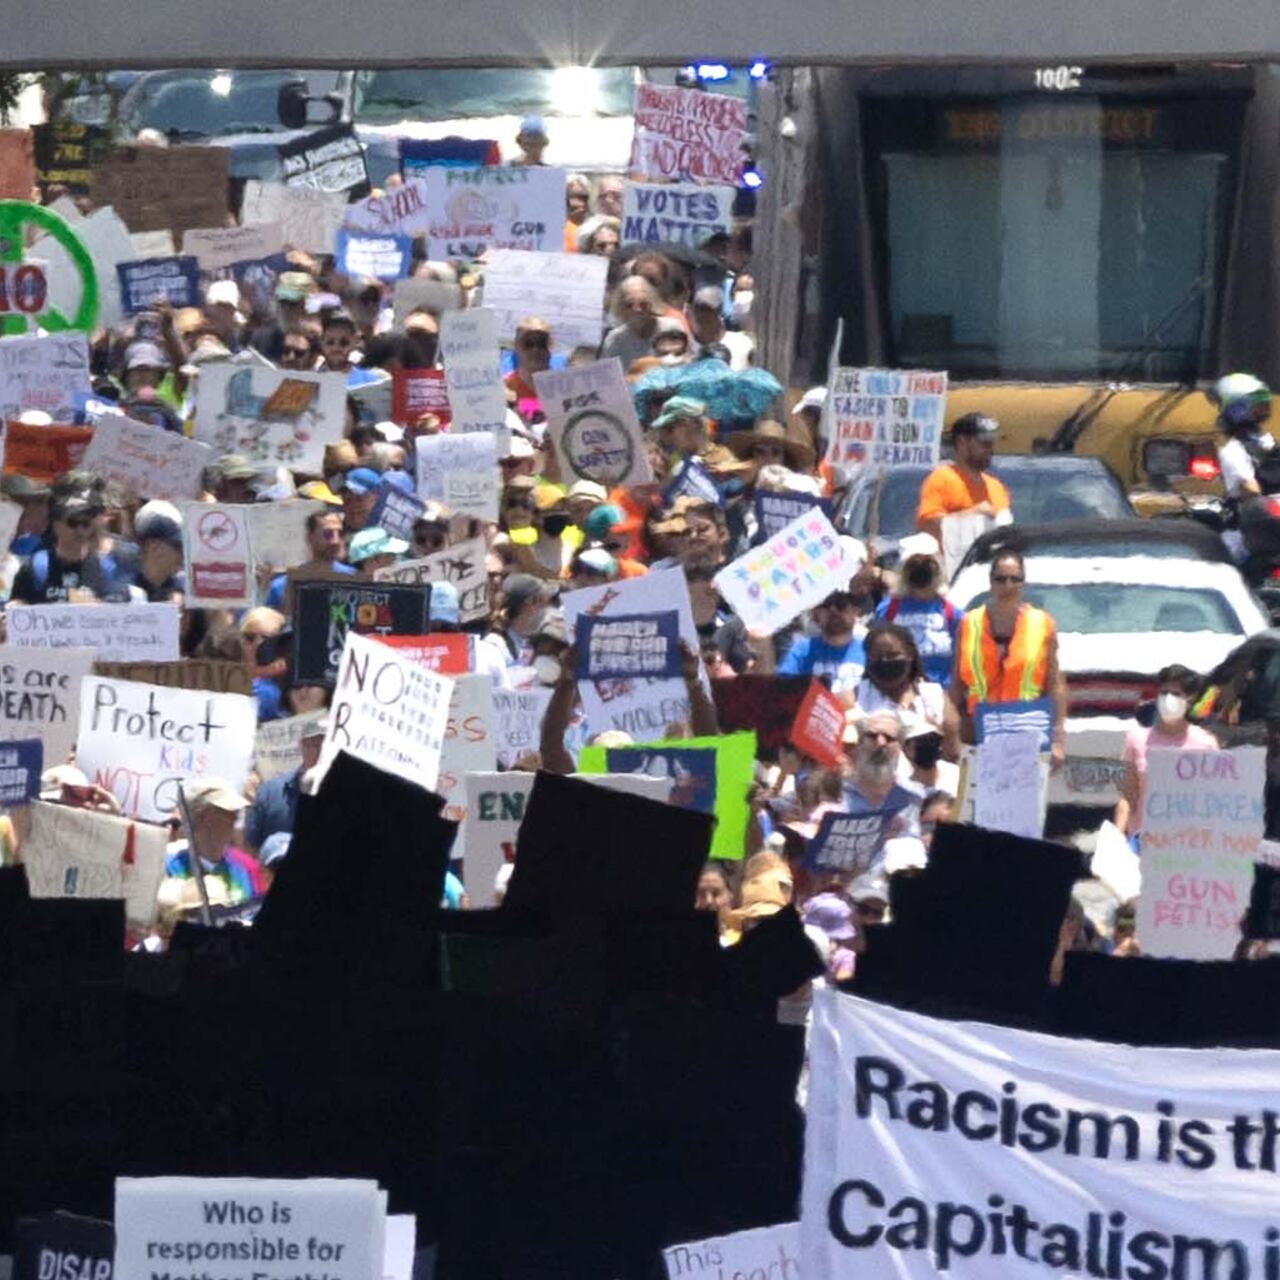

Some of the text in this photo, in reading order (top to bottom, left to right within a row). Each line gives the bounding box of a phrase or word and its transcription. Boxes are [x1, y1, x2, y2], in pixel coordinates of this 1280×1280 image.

[634, 188, 720, 221] VOTES
[23, 669, 70, 690] are
[342, 647, 406, 706] NO
[91, 683, 227, 744] Protect
[159, 743, 209, 774] Kids
[1175, 753, 1240, 781] OUR
[94, 766, 156, 818] NOT
[1145, 792, 1266, 821] CHILDREN
[1167, 874, 1238, 905] GUN
[1153, 901, 1243, 931] FETIS
[854, 1054, 1141, 1163] Racism
[1156, 1100, 1218, 1171] is
[203, 1200, 292, 1225] Who is
[146, 1235, 346, 1268] responsible for
